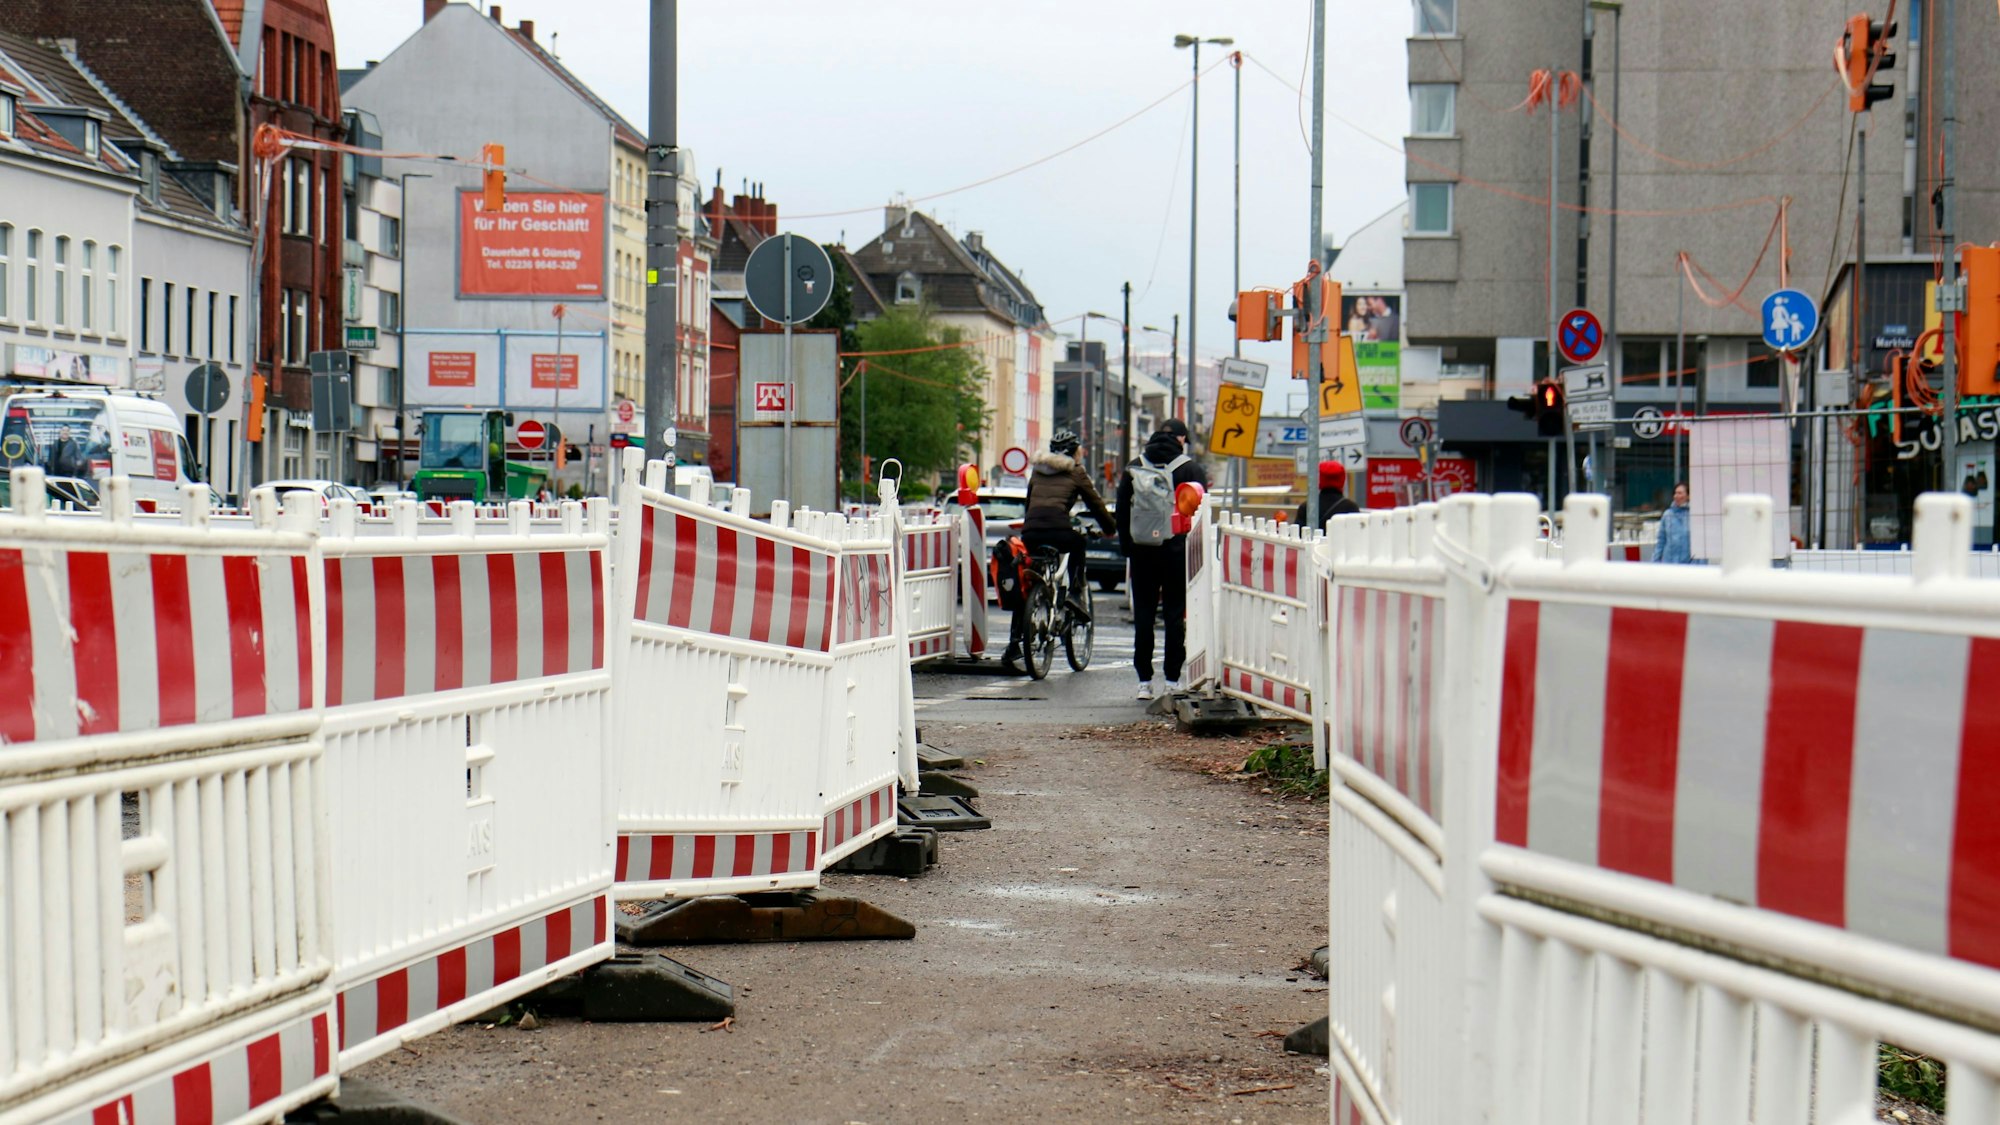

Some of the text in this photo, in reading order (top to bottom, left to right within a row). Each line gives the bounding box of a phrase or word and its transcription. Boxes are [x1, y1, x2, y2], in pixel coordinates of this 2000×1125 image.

[474, 198, 588, 214] Wben Sie hier
[474, 217, 590, 232] für Ihr Geschäft!
[482, 247, 582, 260] Dauerhaft & Günstig
[487, 259, 503, 269] Tel.
